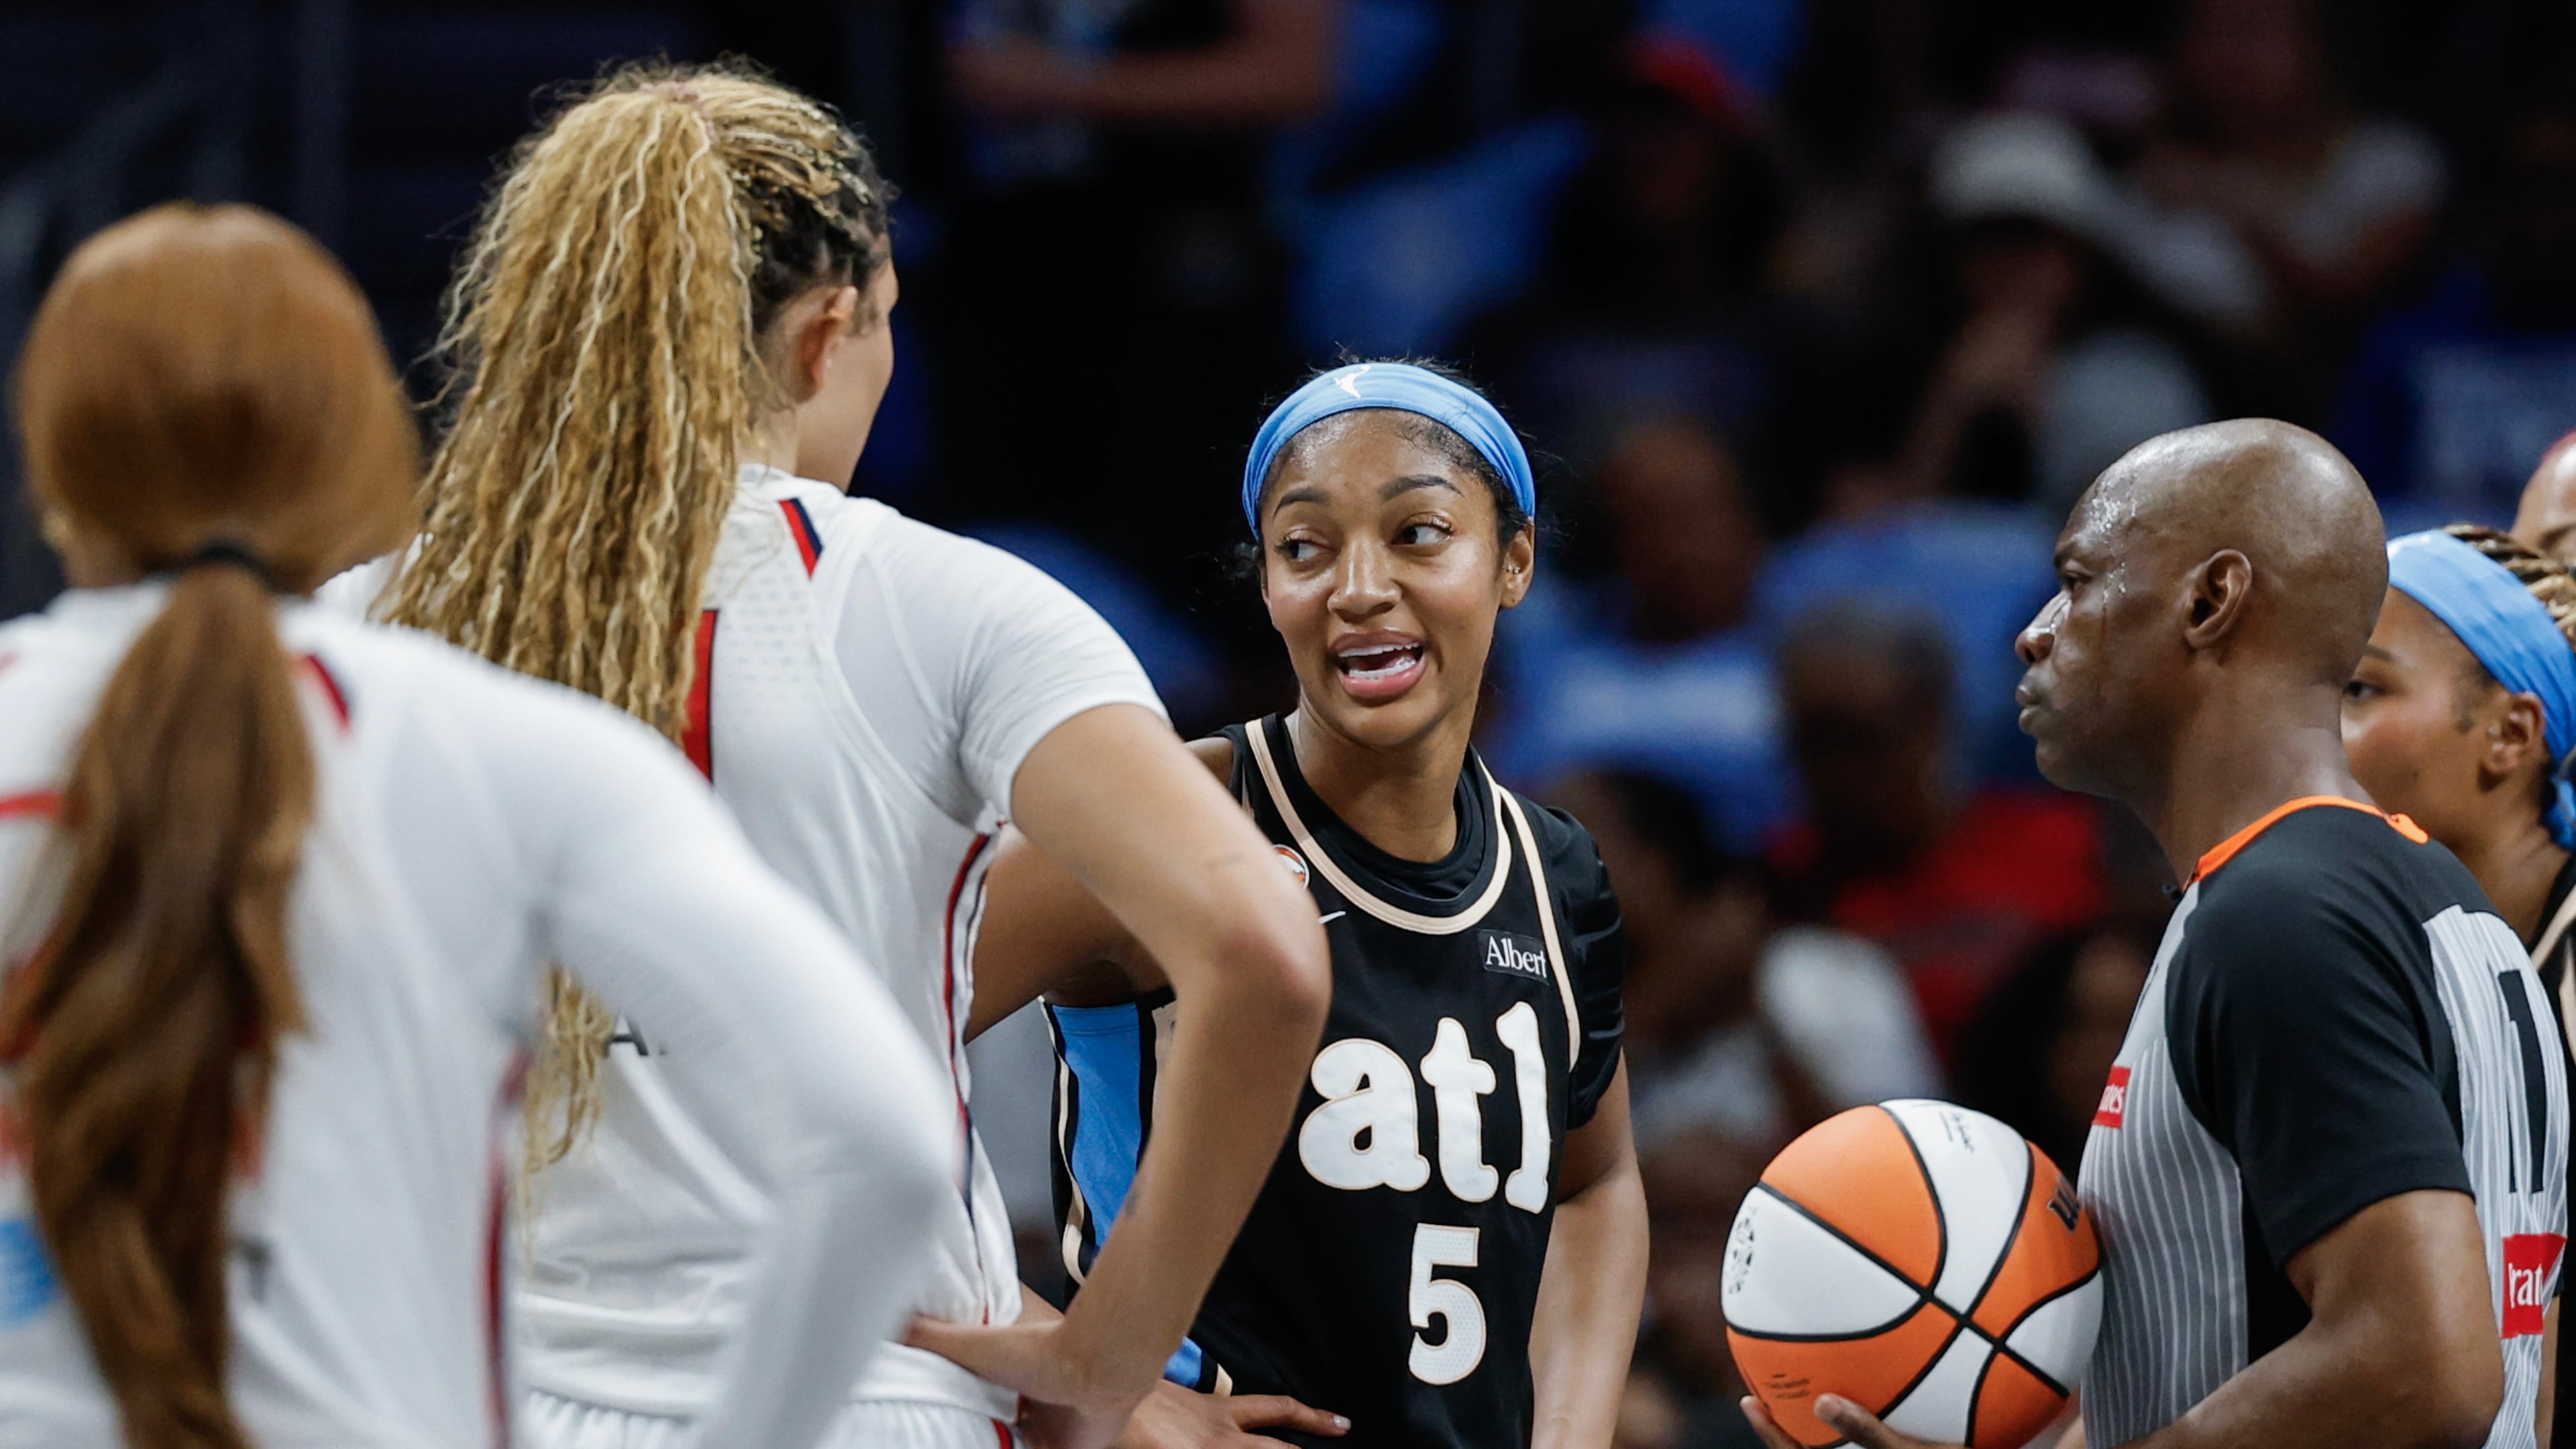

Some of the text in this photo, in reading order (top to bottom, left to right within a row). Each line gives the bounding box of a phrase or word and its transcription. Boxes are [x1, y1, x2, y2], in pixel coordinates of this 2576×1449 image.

[1485, 935, 1547, 979] Albert
[1298, 1000, 1552, 1214] atl
[1408, 1222, 1487, 1385] 5
